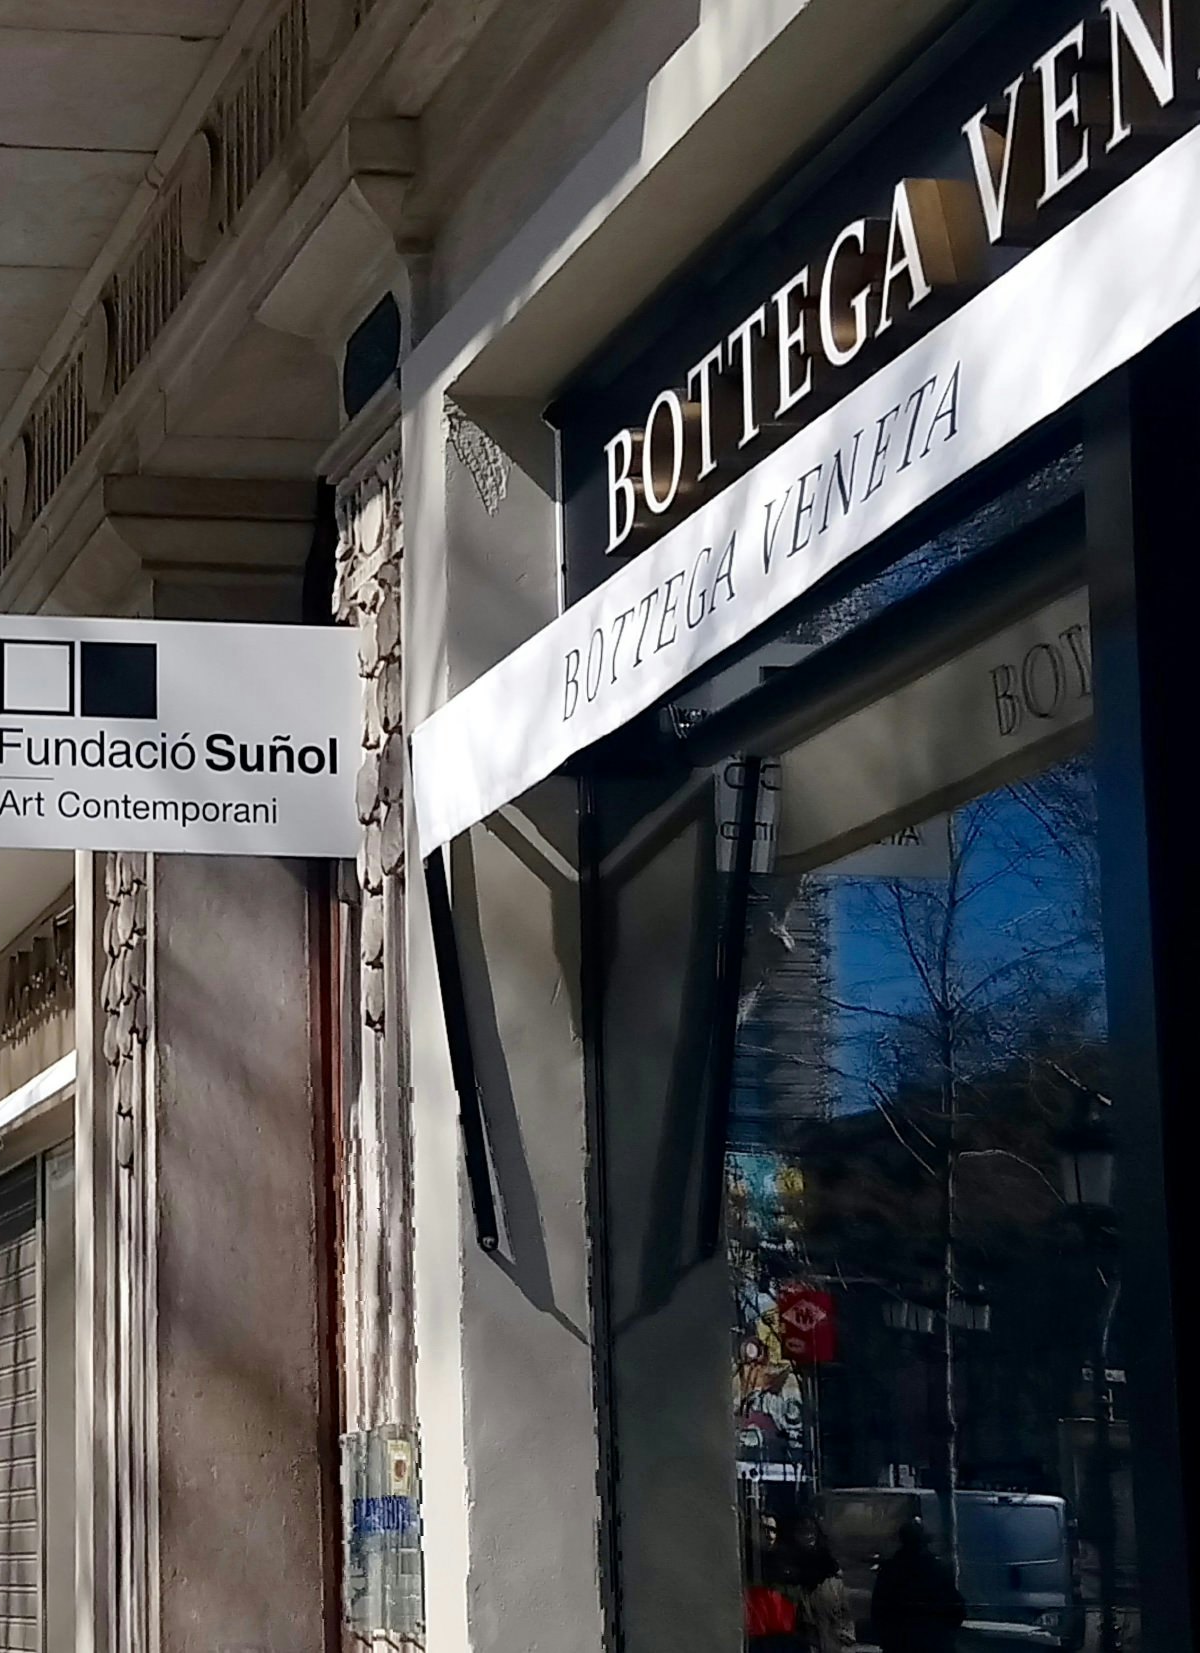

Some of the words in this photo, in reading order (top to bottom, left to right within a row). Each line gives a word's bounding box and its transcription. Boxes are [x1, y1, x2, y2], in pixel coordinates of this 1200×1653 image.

[604, 181, 932, 555] BOTTEGA
[961, 0, 1200, 244] VEN
[563, 530, 737, 722] BOTTEGA
[763, 360, 961, 574] VENETA
[57, 791, 278, 827] Contemporani
[205, 733, 338, 775] Suñol
